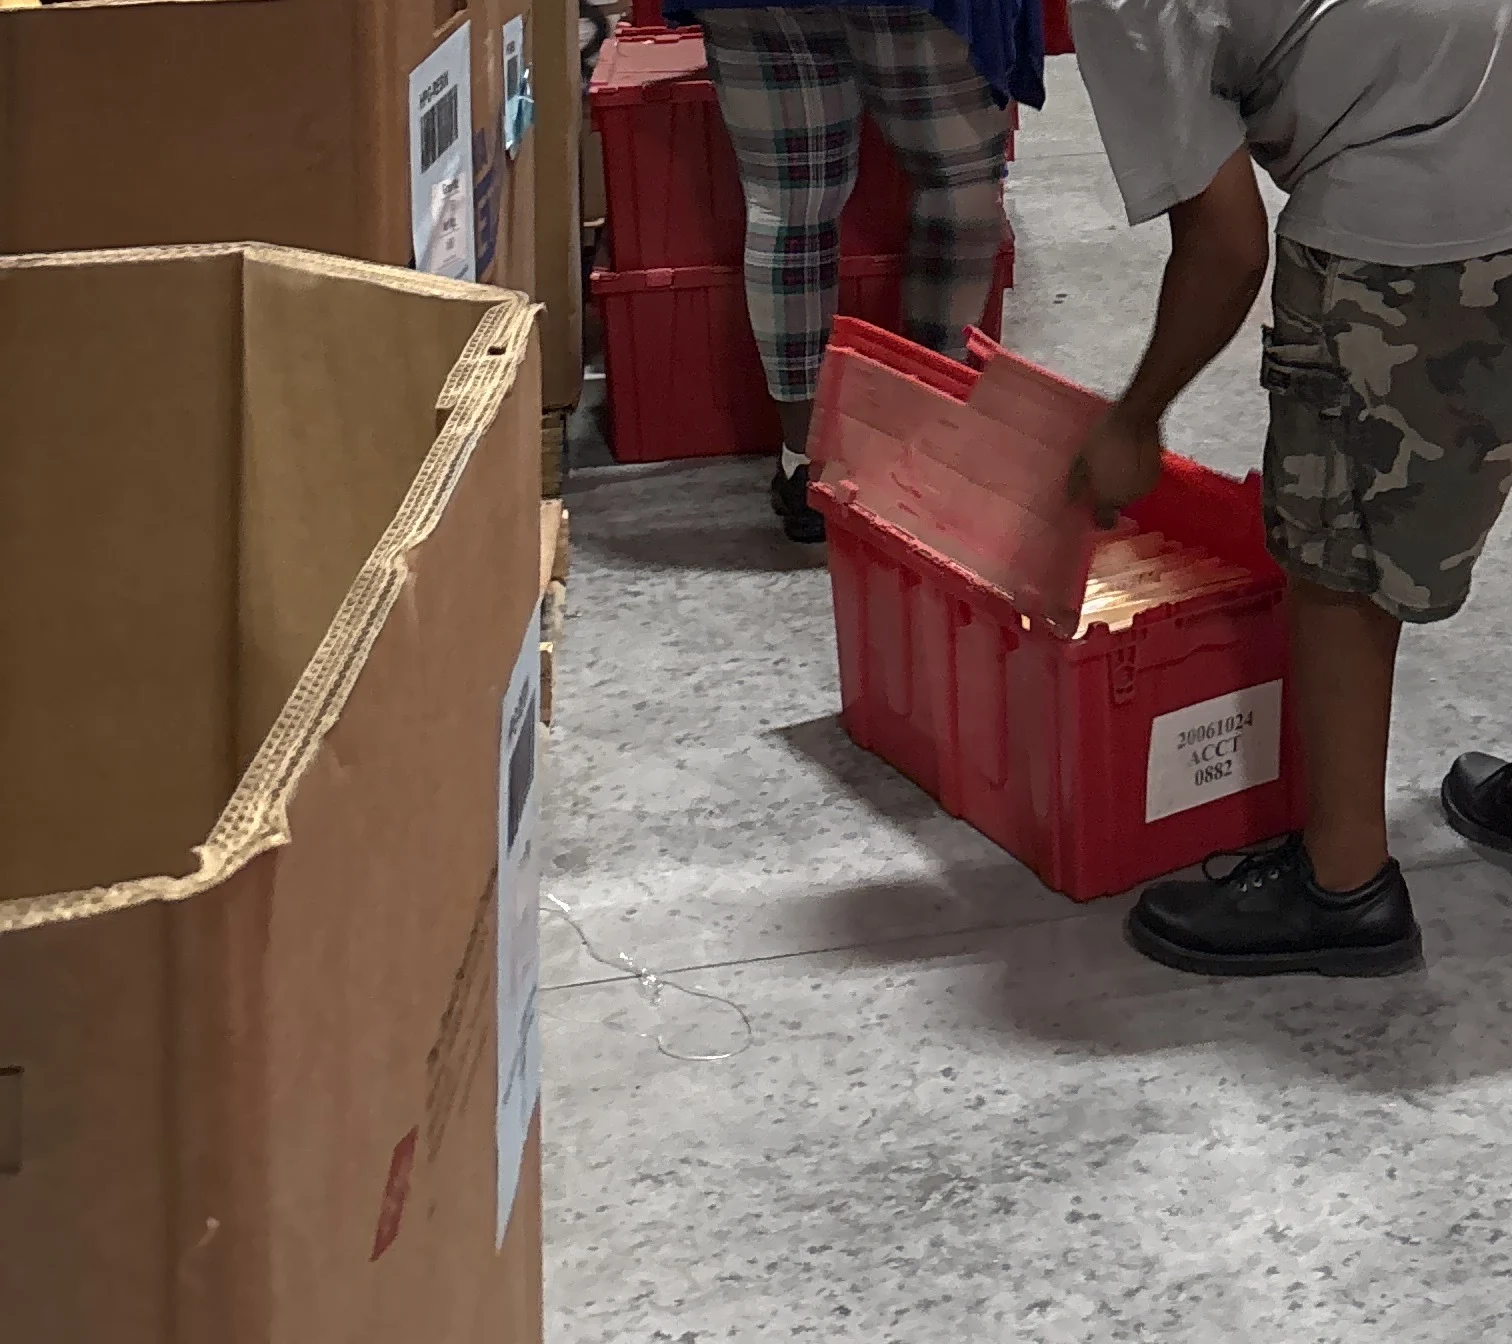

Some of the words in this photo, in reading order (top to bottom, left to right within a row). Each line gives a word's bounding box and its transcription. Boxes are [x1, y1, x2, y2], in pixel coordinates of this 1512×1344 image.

[1177, 710, 1253, 749] 20061024
[1187, 734, 1241, 768] ACCT
[1194, 759, 1233, 786] 0882
